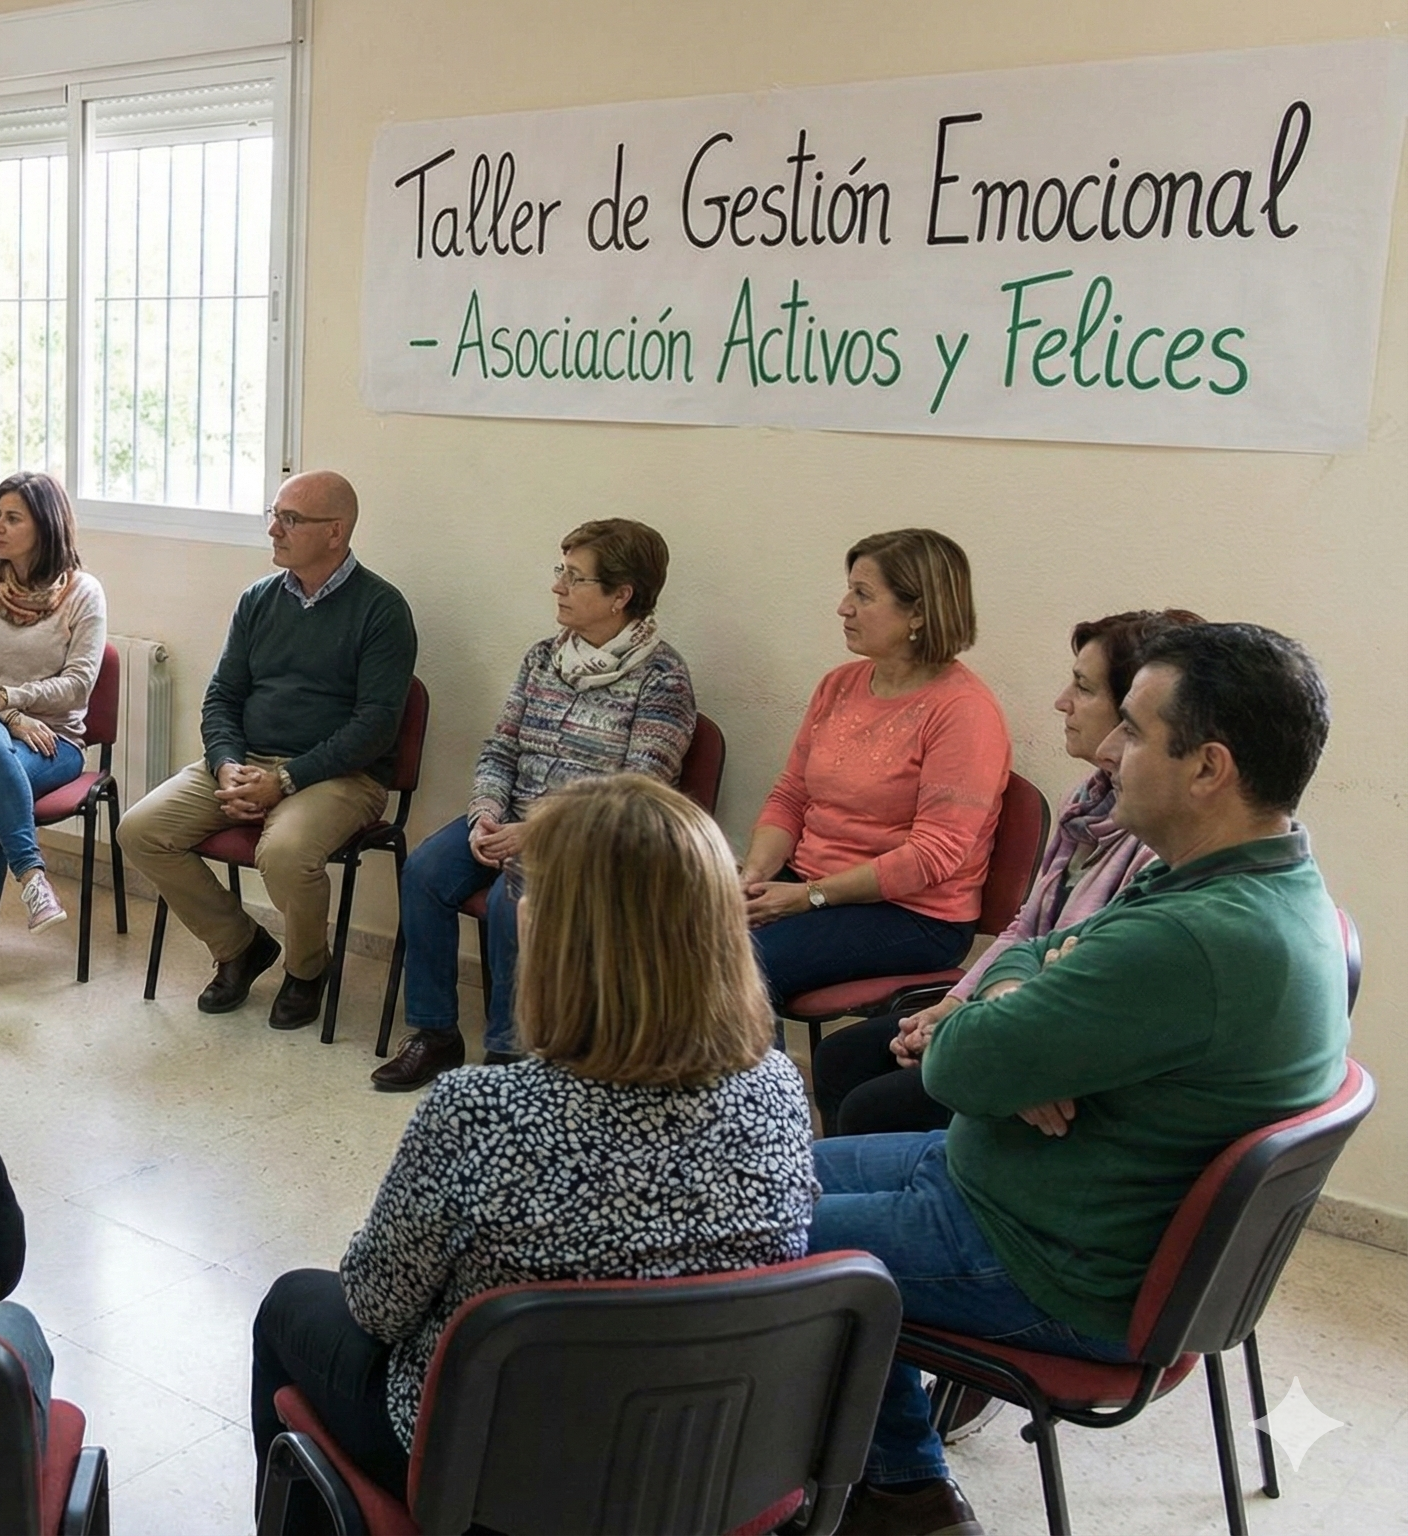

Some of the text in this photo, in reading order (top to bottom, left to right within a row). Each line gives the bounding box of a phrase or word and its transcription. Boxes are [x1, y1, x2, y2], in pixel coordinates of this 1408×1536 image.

[394, 100, 1312, 260] Taller de Gestión Emocional
[451, 288, 694, 383] Asociación
[716, 276, 901, 388] Activos
[929, 332, 969, 415] y
[1000, 269, 1248, 396] Felices
